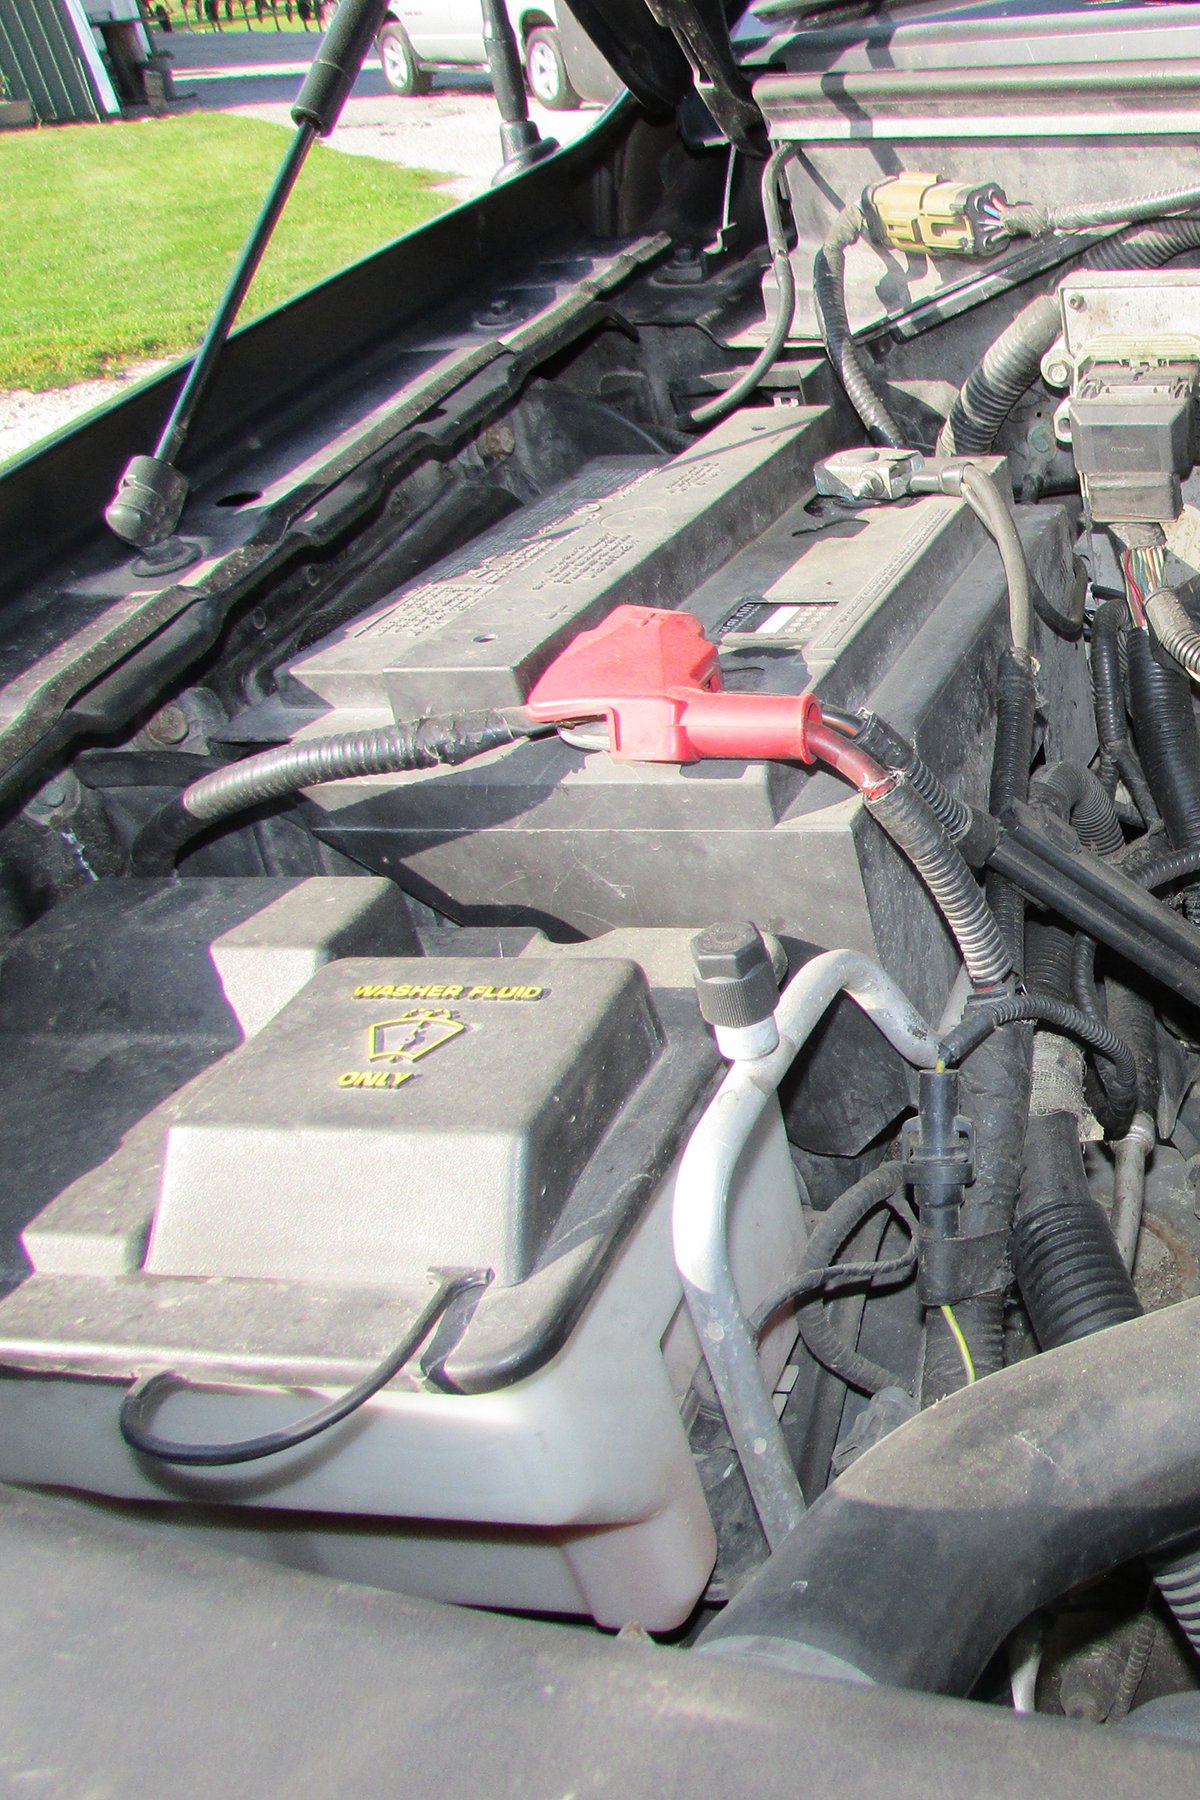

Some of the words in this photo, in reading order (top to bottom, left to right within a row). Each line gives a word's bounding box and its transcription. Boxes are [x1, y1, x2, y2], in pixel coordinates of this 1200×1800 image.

[352, 984, 465, 999] WASHER
[467, 985, 545, 1000] FLUID
[336, 1071, 414, 1088] ONLY
